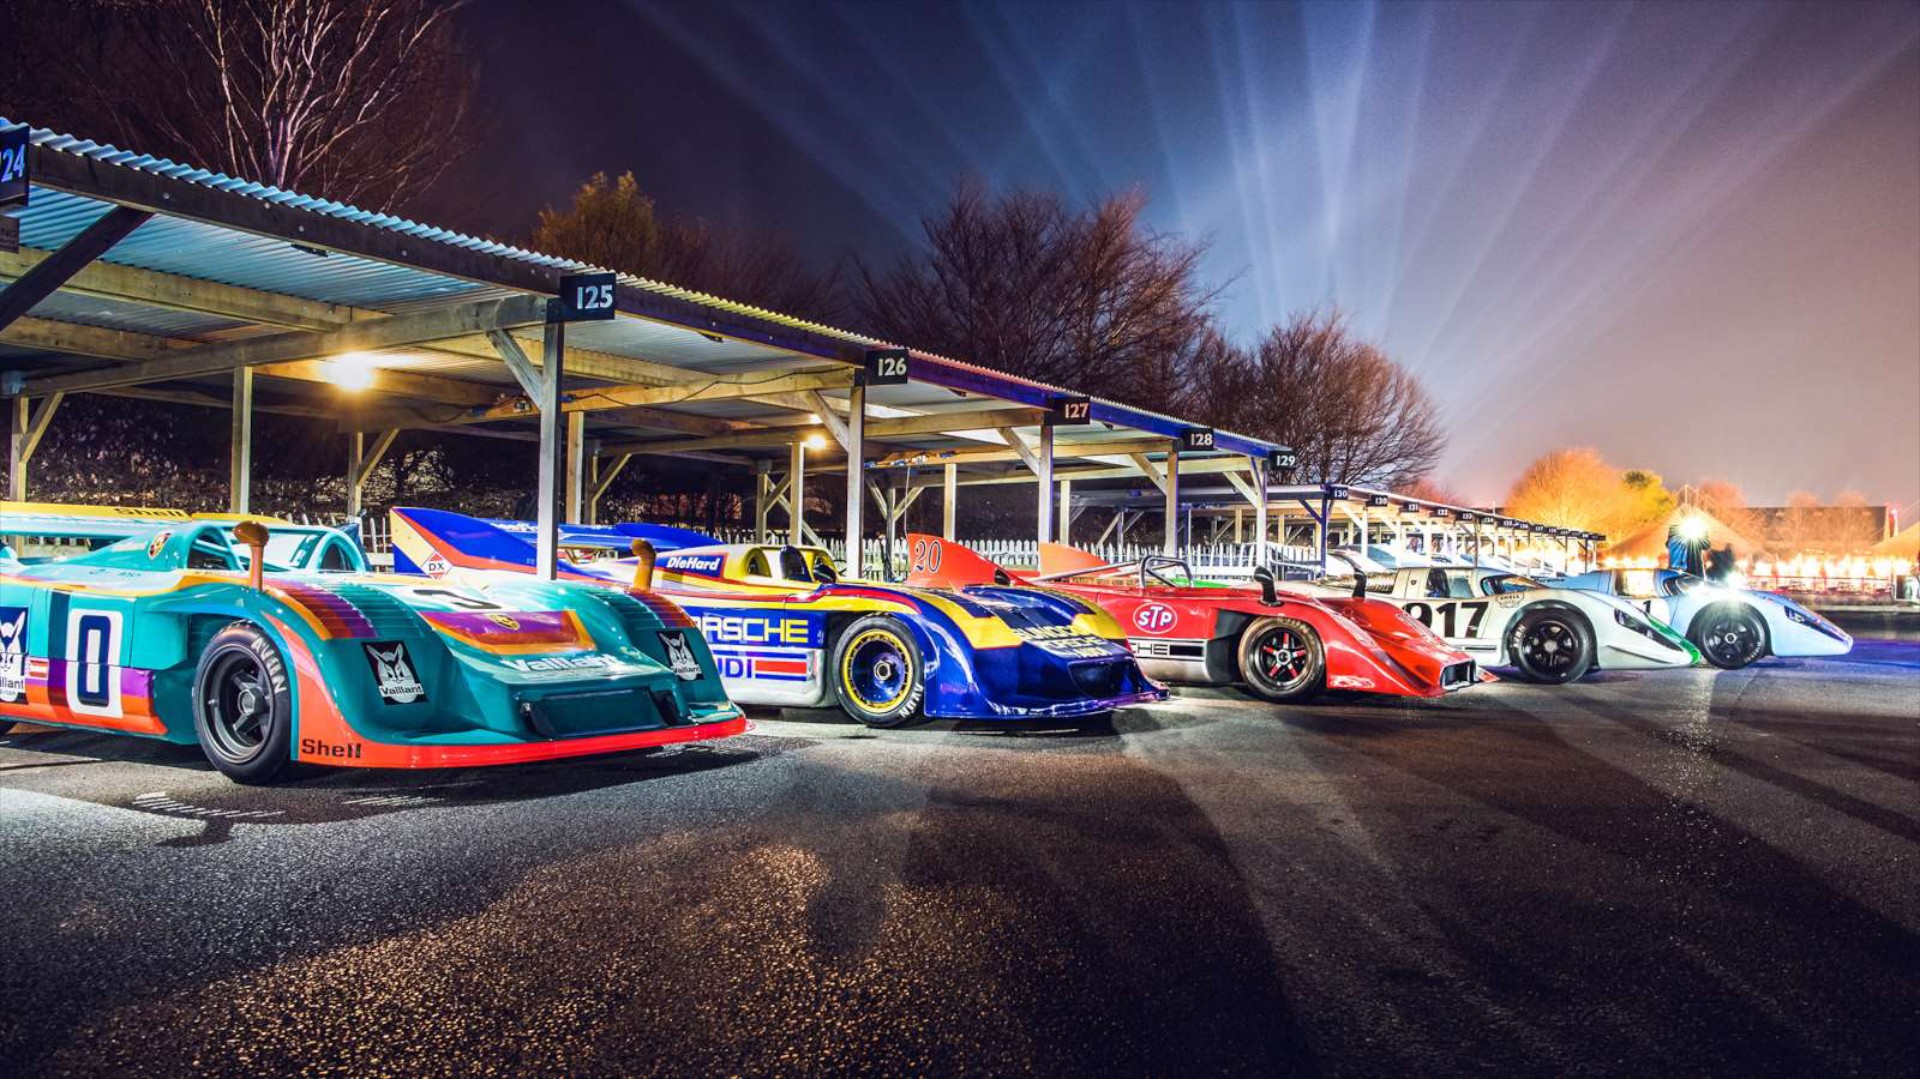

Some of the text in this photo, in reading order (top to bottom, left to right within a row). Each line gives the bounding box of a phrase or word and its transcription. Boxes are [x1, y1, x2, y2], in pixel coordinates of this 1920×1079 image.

[0, 144, 25, 182] 24
[576, 285, 613, 310] 125
[878, 358, 907, 376] 126
[1065, 402, 1089, 418] 127
[1190, 433, 1213, 446] 128
[1276, 455, 1296, 466] 129
[1333, 489, 1348, 498] 130
[114, 508, 183, 517] Shell
[666, 556, 721, 571] DieHard
[914, 540, 942, 573] 20
[428, 562, 445, 572] DX
[1138, 605, 1173, 630] STP
[1402, 601, 1489, 638] 917
[73, 611, 116, 712] 0
[251, 635, 288, 694] AVON
[499, 653, 624, 673] Vaillant
[382, 685, 422, 696] Vaillant
[302, 738, 361, 759] Shell
